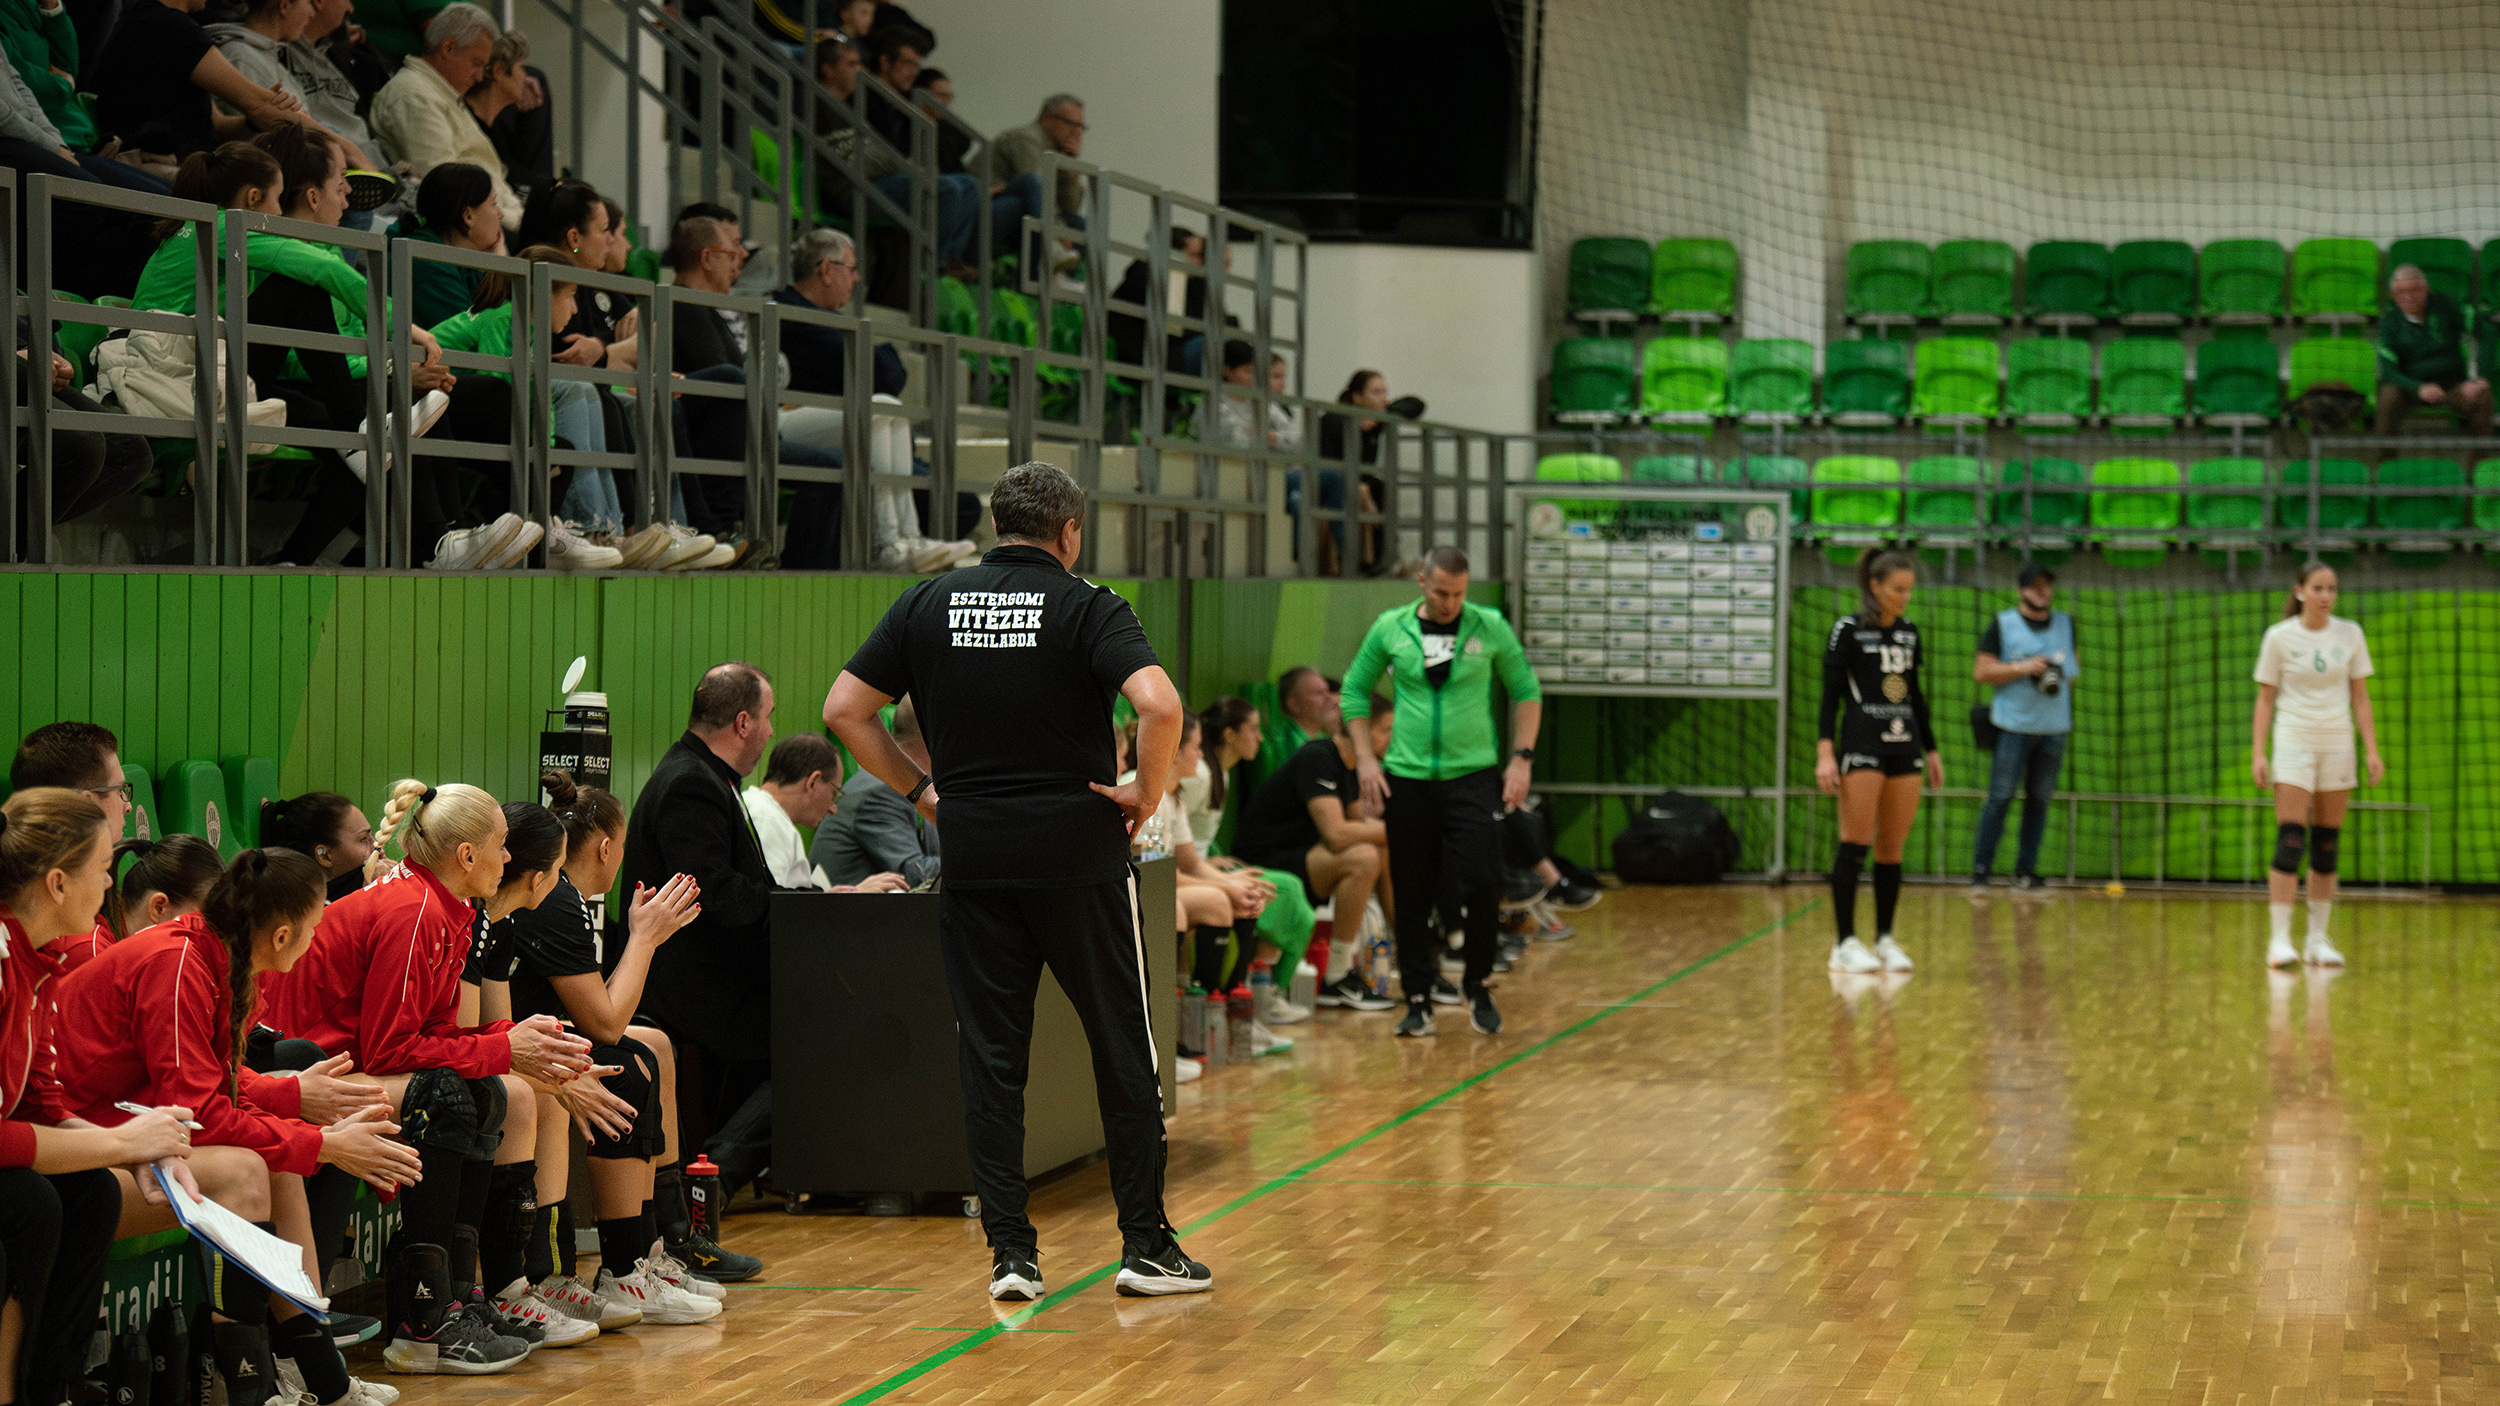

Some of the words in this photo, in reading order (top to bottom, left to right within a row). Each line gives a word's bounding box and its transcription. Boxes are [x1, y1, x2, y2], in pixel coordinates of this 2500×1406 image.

[949, 592, 1045, 606] ESZTERGOMI
[948, 606, 1043, 630] VITÉZEK
[951, 630, 1037, 648] KÉZILABDA
[2313, 649, 2327, 673] 6
[542, 754, 579, 767] SELECT
[584, 755, 610, 769] SELECT
